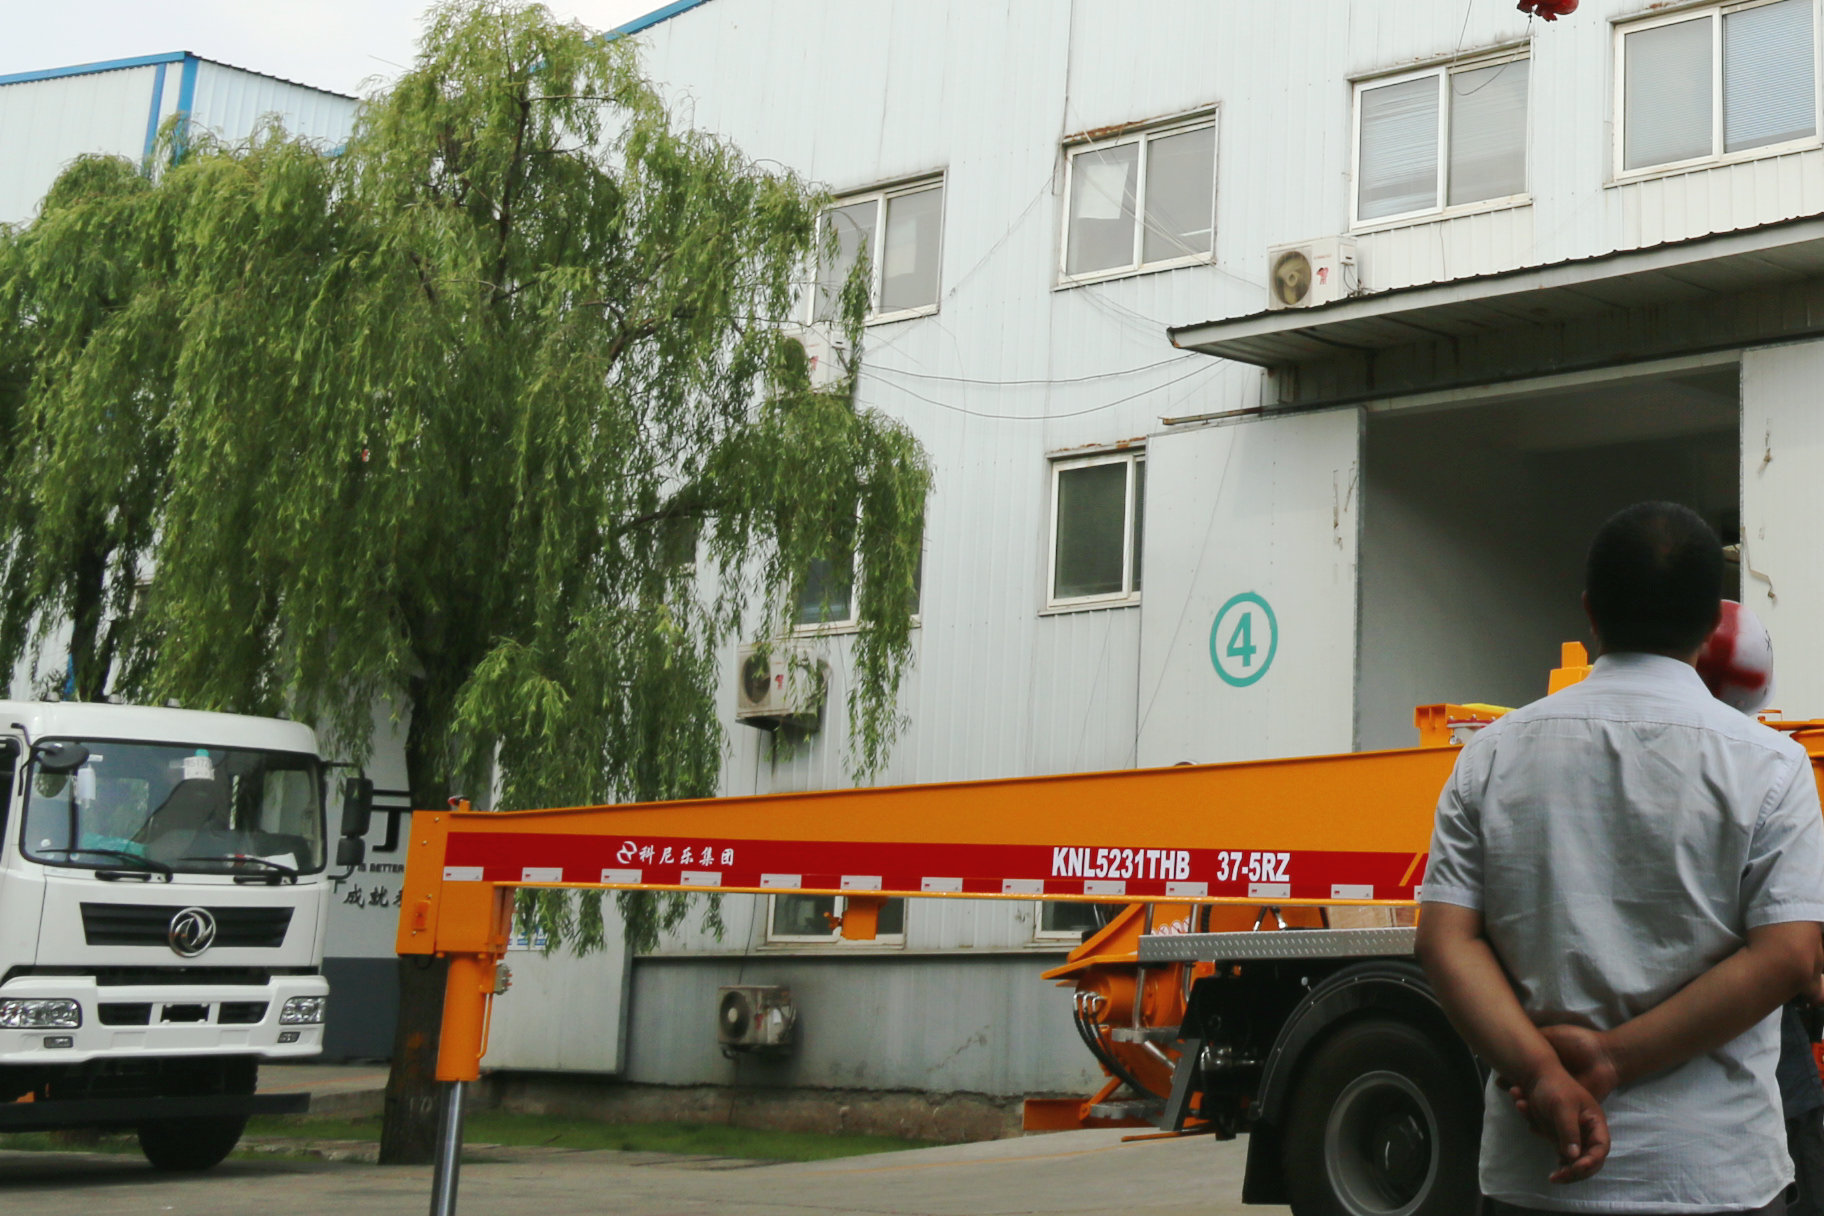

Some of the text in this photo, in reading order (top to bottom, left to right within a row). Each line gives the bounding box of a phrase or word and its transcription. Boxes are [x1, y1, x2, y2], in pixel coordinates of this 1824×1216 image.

[1226, 612, 1257, 667] 4
[638, 844, 735, 867] 科尼乐集团
[1051, 847, 1291, 882] KNL5231THB 37-5RZ
